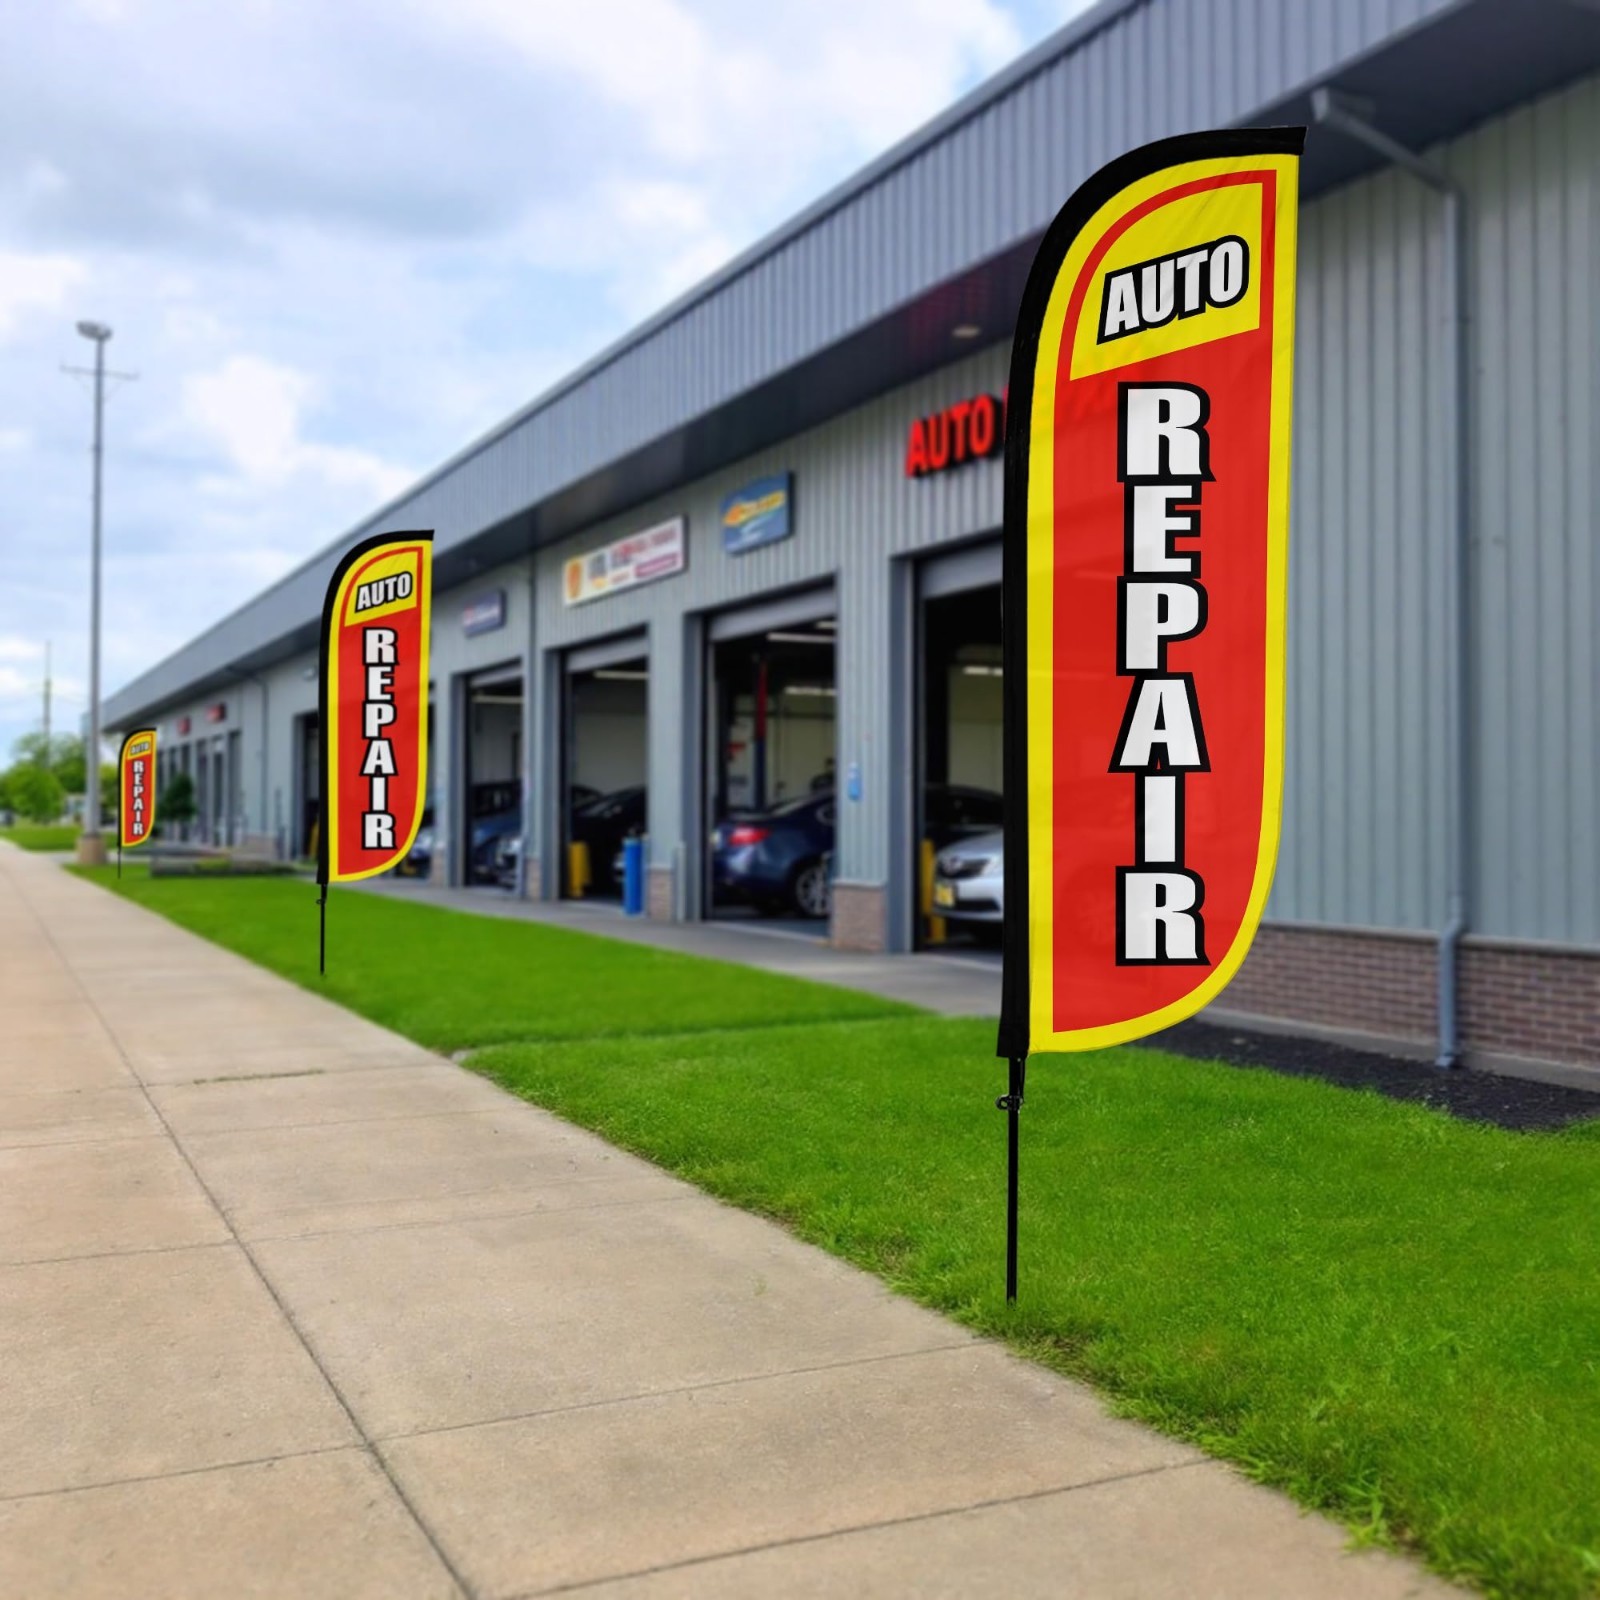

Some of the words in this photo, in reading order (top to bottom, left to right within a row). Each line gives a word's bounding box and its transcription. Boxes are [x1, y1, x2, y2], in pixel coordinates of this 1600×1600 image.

[1099, 237, 1247, 342] AUTO
[905, 393, 994, 478] AUTO
[355, 571, 412, 612] AUTO
[1112, 384, 1210, 962] REPAIR
[130, 741, 150, 755] AUTO
[361, 628, 397, 849] REPAIR
[132, 760, 144, 836] REPAIR
